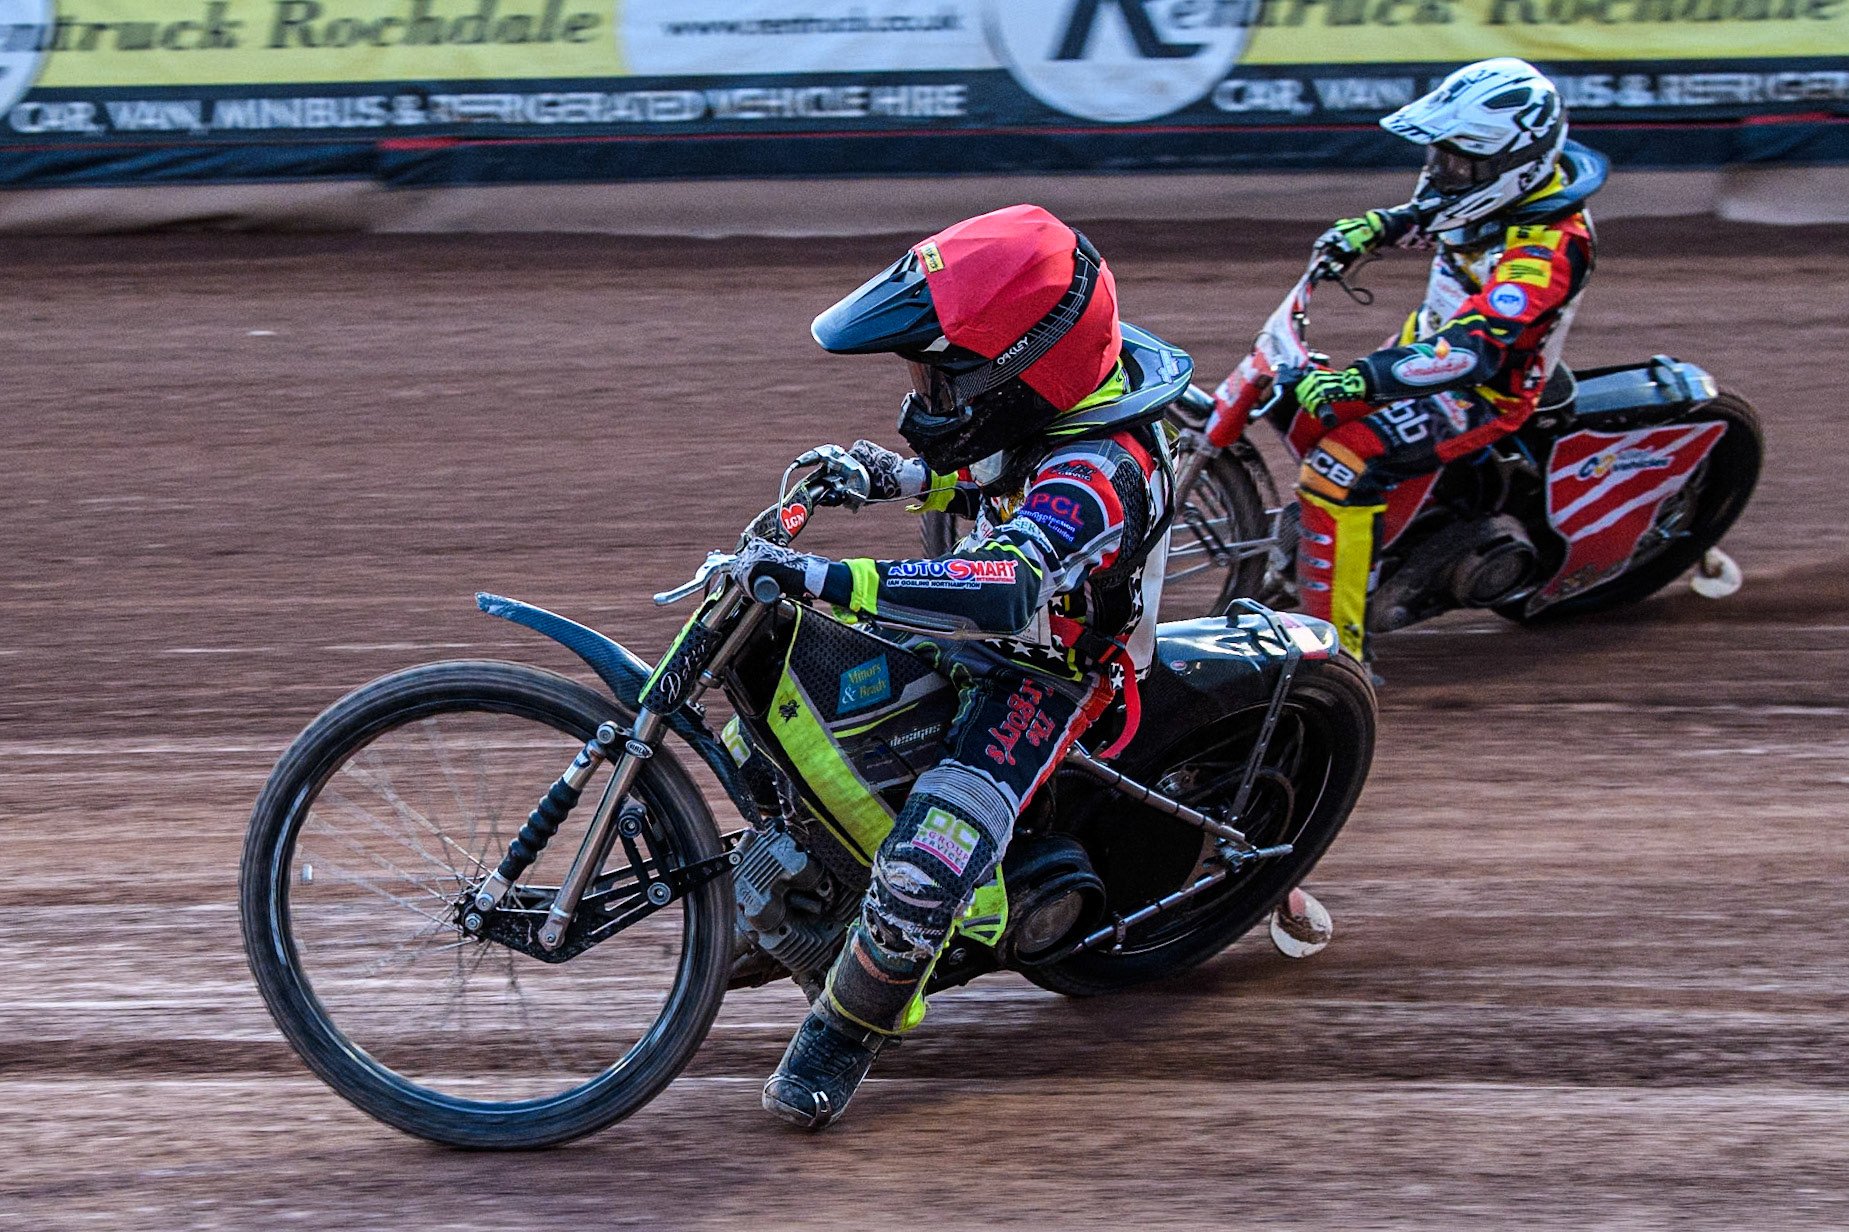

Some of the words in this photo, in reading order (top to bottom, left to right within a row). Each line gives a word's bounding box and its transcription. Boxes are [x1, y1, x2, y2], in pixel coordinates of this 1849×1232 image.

[264, 0, 601, 50] Rochdale
[1030, 492, 1085, 526] PCL
[784, 512, 805, 530] LGN
[888, 559, 1019, 581] AUTOSMART
[887, 579, 900, 587] IAN
[848, 663, 882, 684] Minors
[841, 685, 857, 704] &
[860, 679, 887, 699] Brady
[928, 830, 969, 861] GROUP
